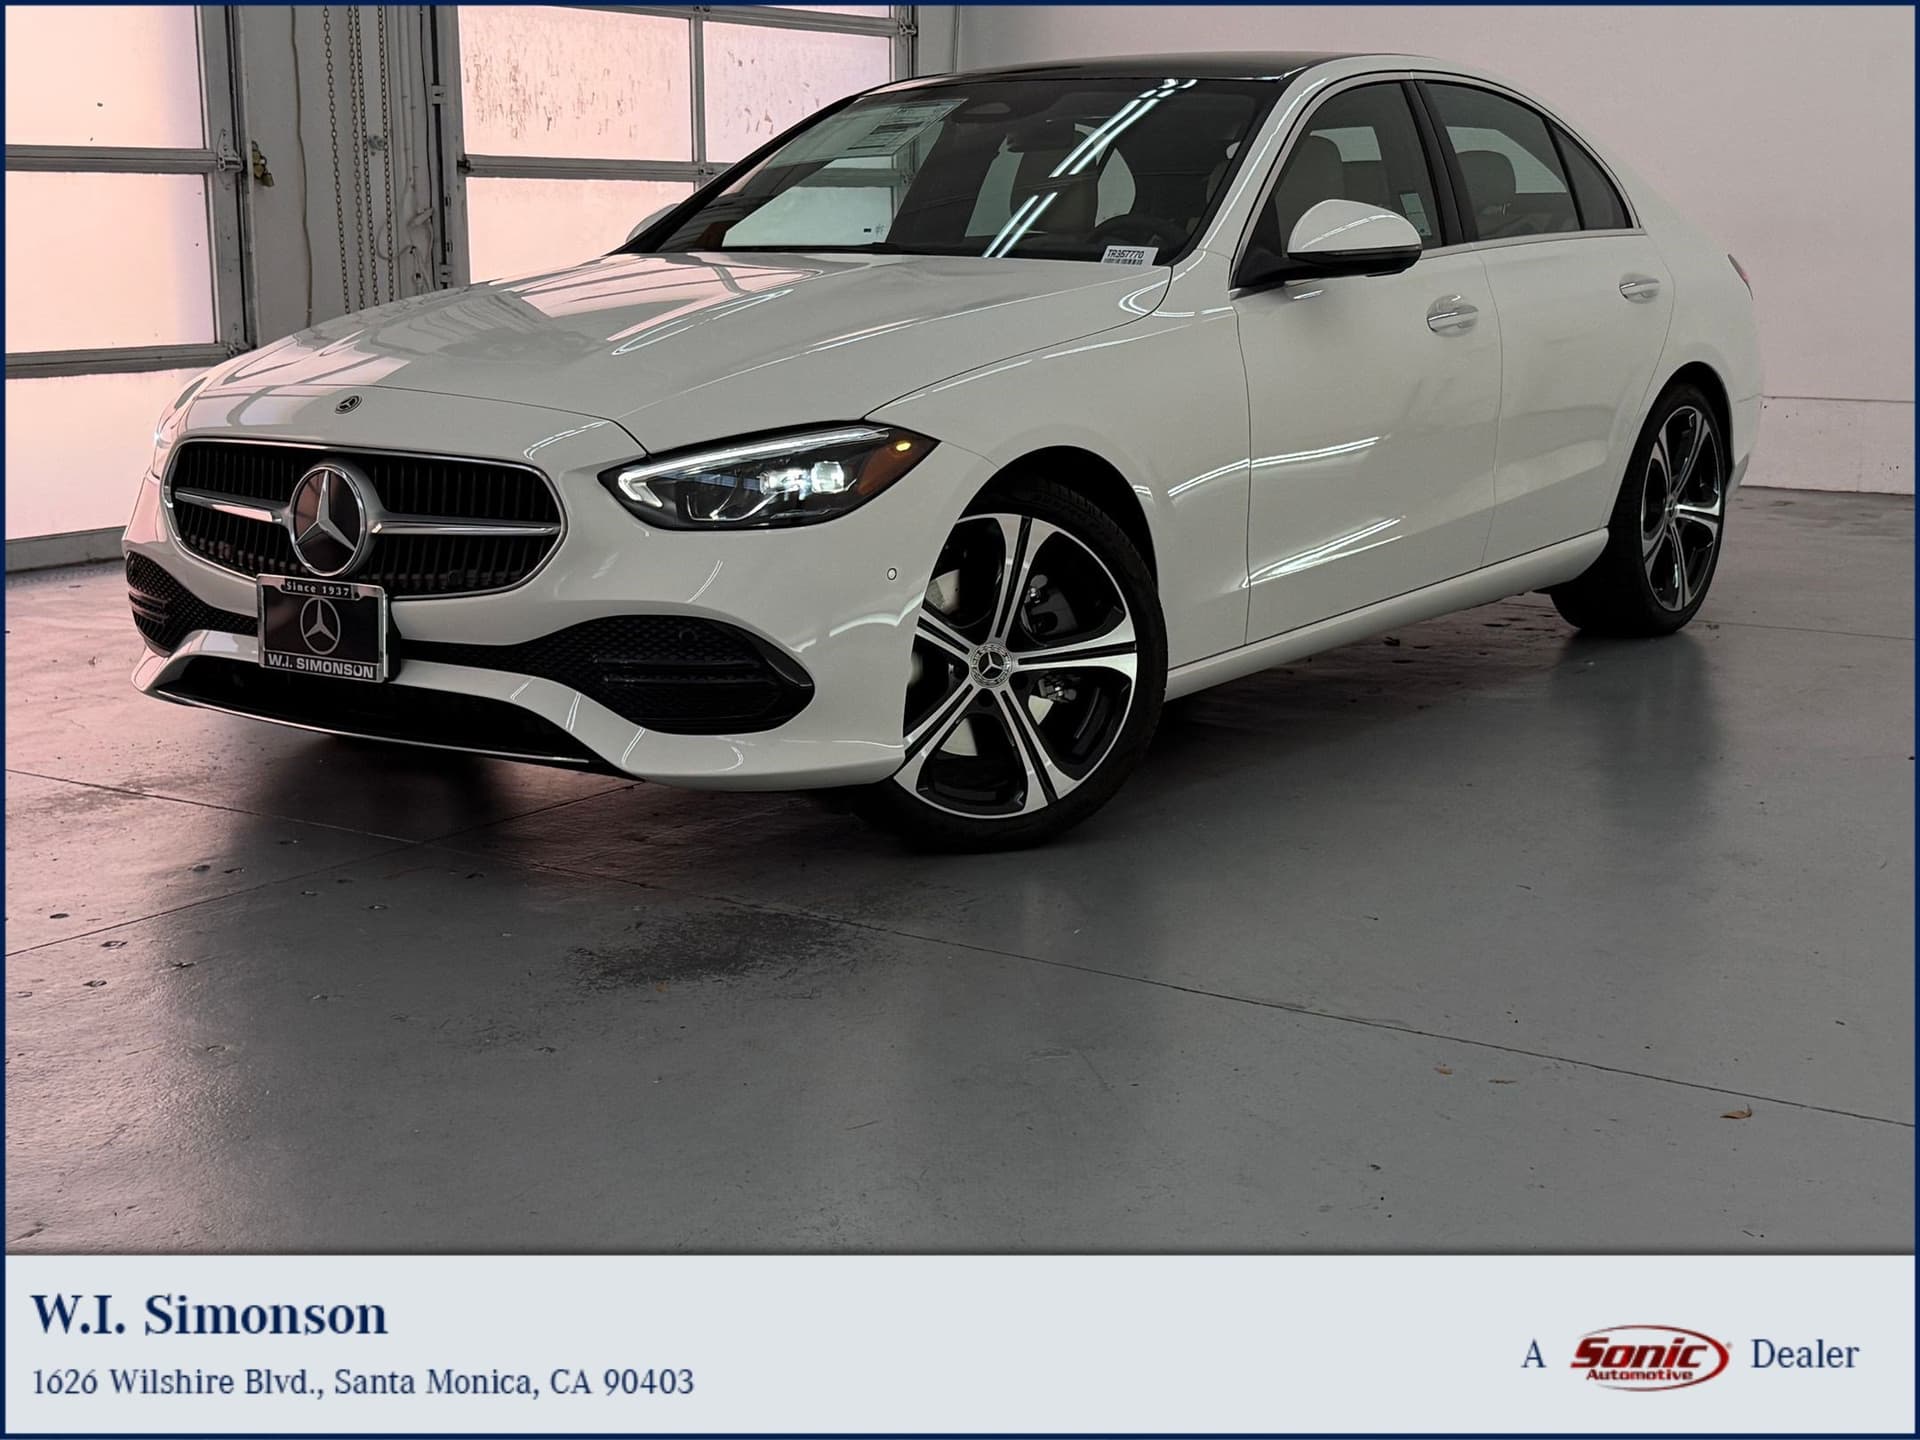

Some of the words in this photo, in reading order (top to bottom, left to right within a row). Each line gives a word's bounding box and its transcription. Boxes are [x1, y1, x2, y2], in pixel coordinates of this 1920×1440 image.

[286, 581, 317, 593] Since
[322, 586, 351, 597] 1937
[268, 653, 293, 668] W.I.
[296, 659, 374, 679] SIMONSON
